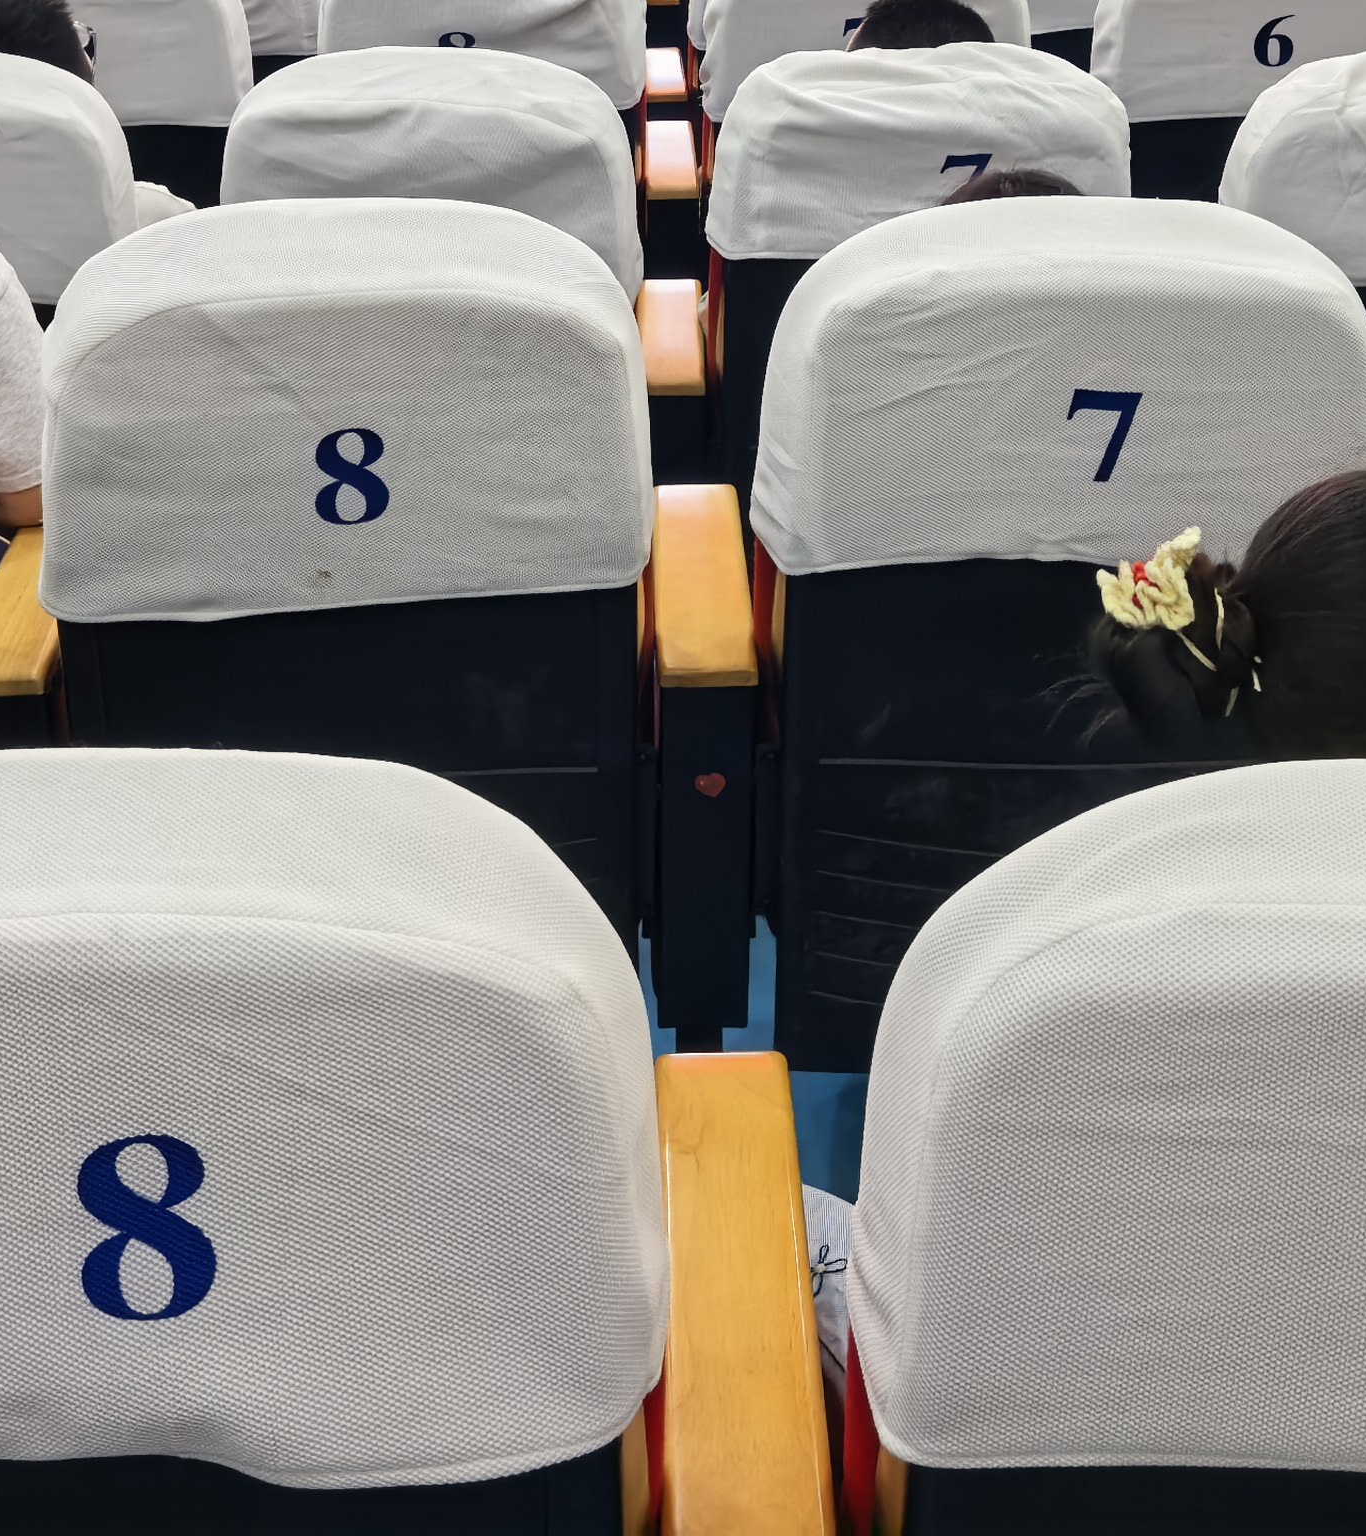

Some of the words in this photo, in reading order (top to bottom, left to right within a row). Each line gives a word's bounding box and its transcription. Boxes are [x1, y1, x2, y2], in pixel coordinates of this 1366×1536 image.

[1253, 14, 1296, 68] 6
[314, 427, 391, 526] 8
[1066, 388, 1144, 483] 7
[76, 1132, 218, 1322] 8
